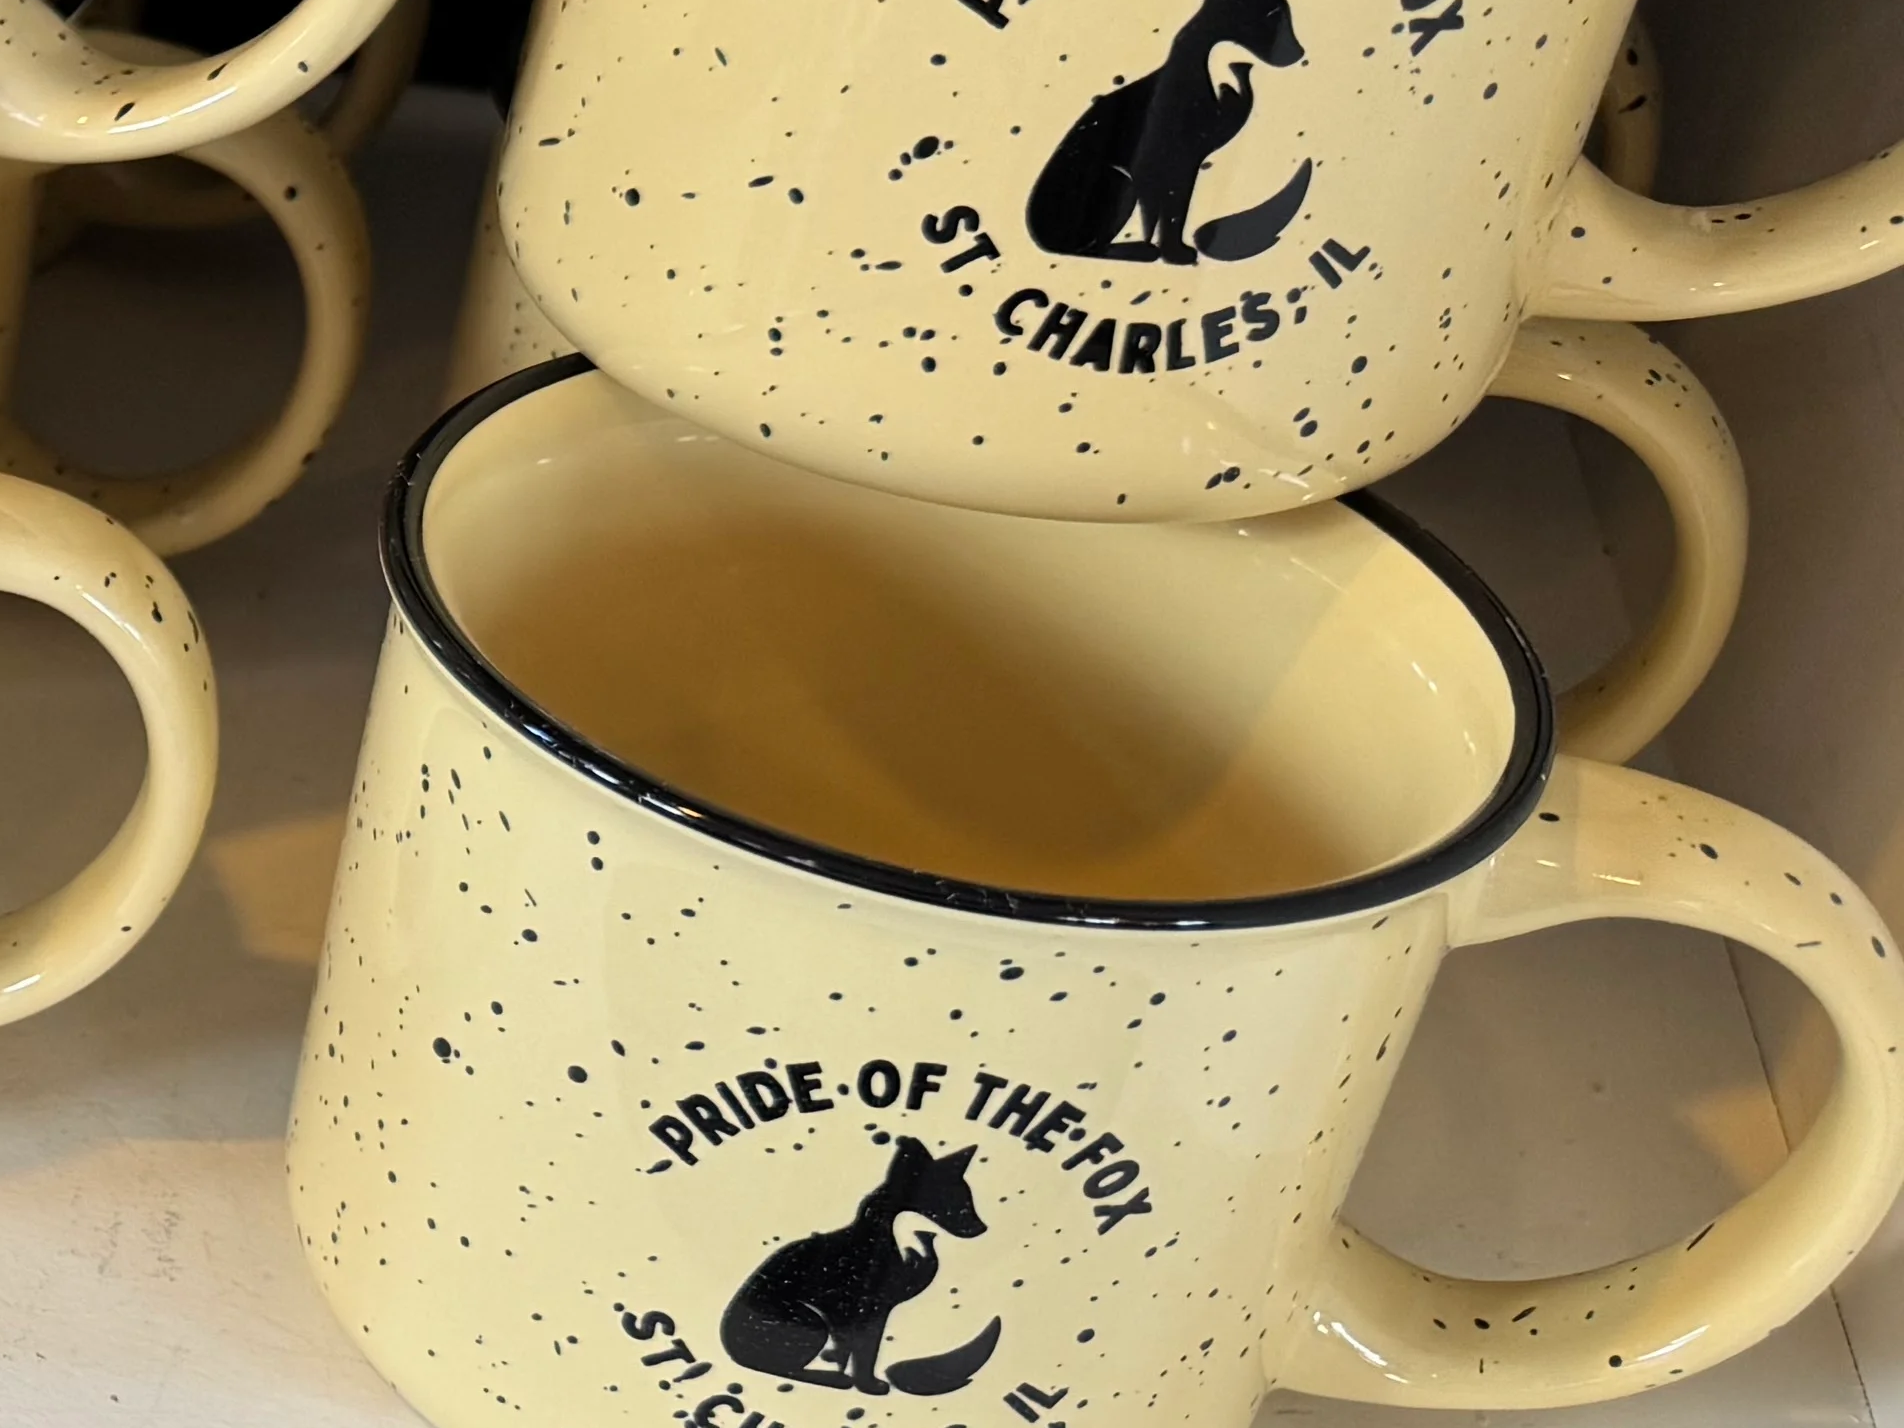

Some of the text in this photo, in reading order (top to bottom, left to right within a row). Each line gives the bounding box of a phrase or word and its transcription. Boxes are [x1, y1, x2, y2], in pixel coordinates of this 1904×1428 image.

[1308, 238, 1371, 290] IL
[648, 1059, 1152, 1236] PRIDE OF THE FOX
[1002, 1382, 1069, 1424] IL
